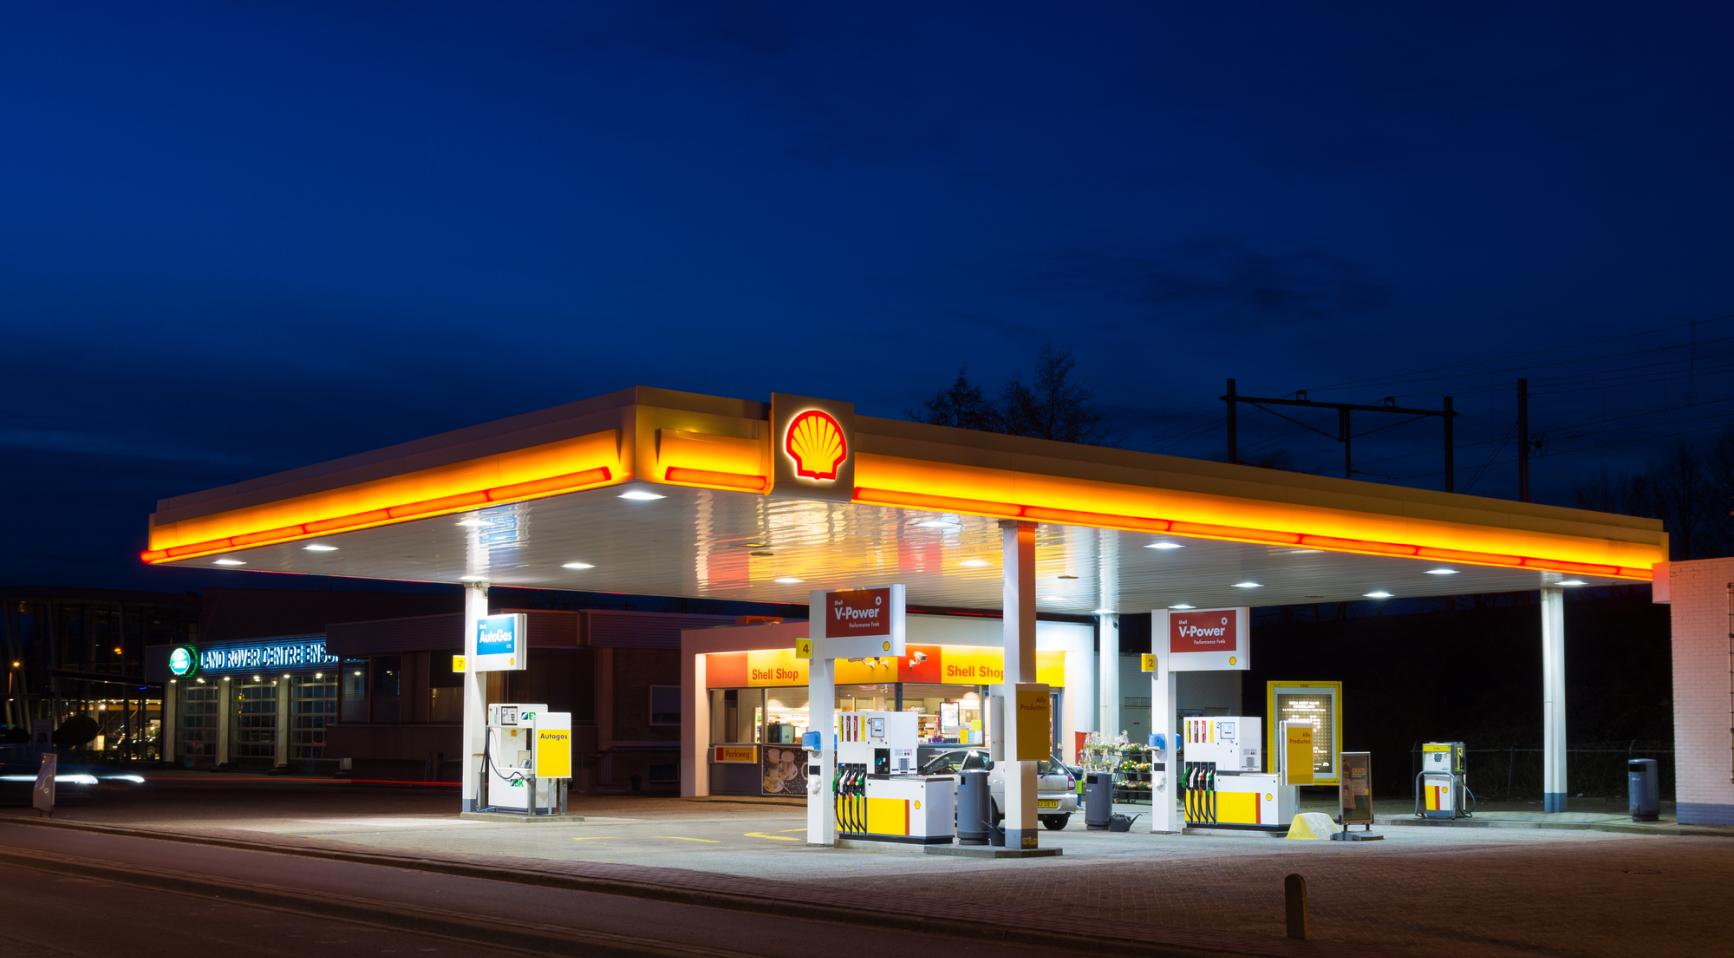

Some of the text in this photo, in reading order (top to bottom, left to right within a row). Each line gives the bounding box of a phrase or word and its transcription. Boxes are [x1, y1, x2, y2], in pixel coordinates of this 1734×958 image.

[834, 606, 880, 620] V-Power
[479, 628, 512, 643] AutoGas
[1178, 626, 1226, 638] V-Power
[802, 643, 809, 653] 4
[200, 650, 225, 669] LAND
[227, 648, 261, 668] ROVER
[262, 645, 304, 666] CENTRE
[1148, 658, 1153, 668] 2
[458, 660, 464, 668] 7
[752, 668, 799, 681] Shell Shop
[947, 665, 975, 677] Shell
[540, 733, 568, 741] Autogas
